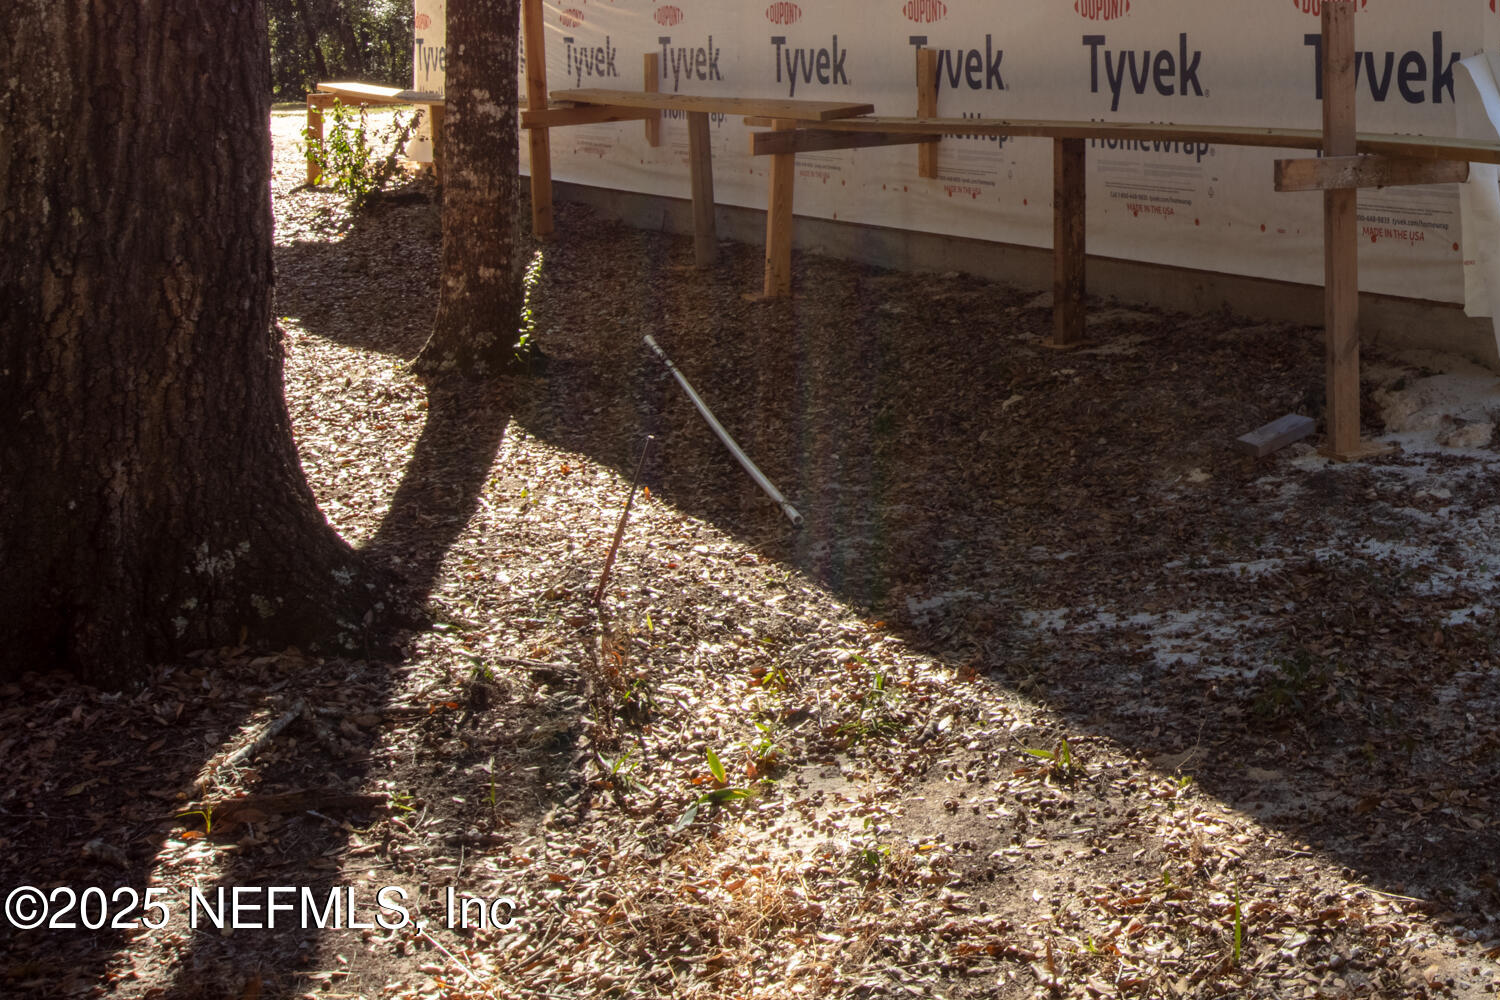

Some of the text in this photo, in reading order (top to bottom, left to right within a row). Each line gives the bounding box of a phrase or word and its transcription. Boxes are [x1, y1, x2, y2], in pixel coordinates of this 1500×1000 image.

[656, 5, 681, 26] DUPONT
[769, 2, 798, 25] DUPONT
[416, 38, 446, 81] Tyve
[563, 35, 617, 88] Tyvek
[658, 35, 721, 92] Tyvek
[771, 35, 848, 97] Tyvek
[1082, 33, 1204, 112] Tyvek
[1362, 227, 1383, 237] MADE
[1394, 229, 1407, 240] THE
[1409, 231, 1424, 241] USA
